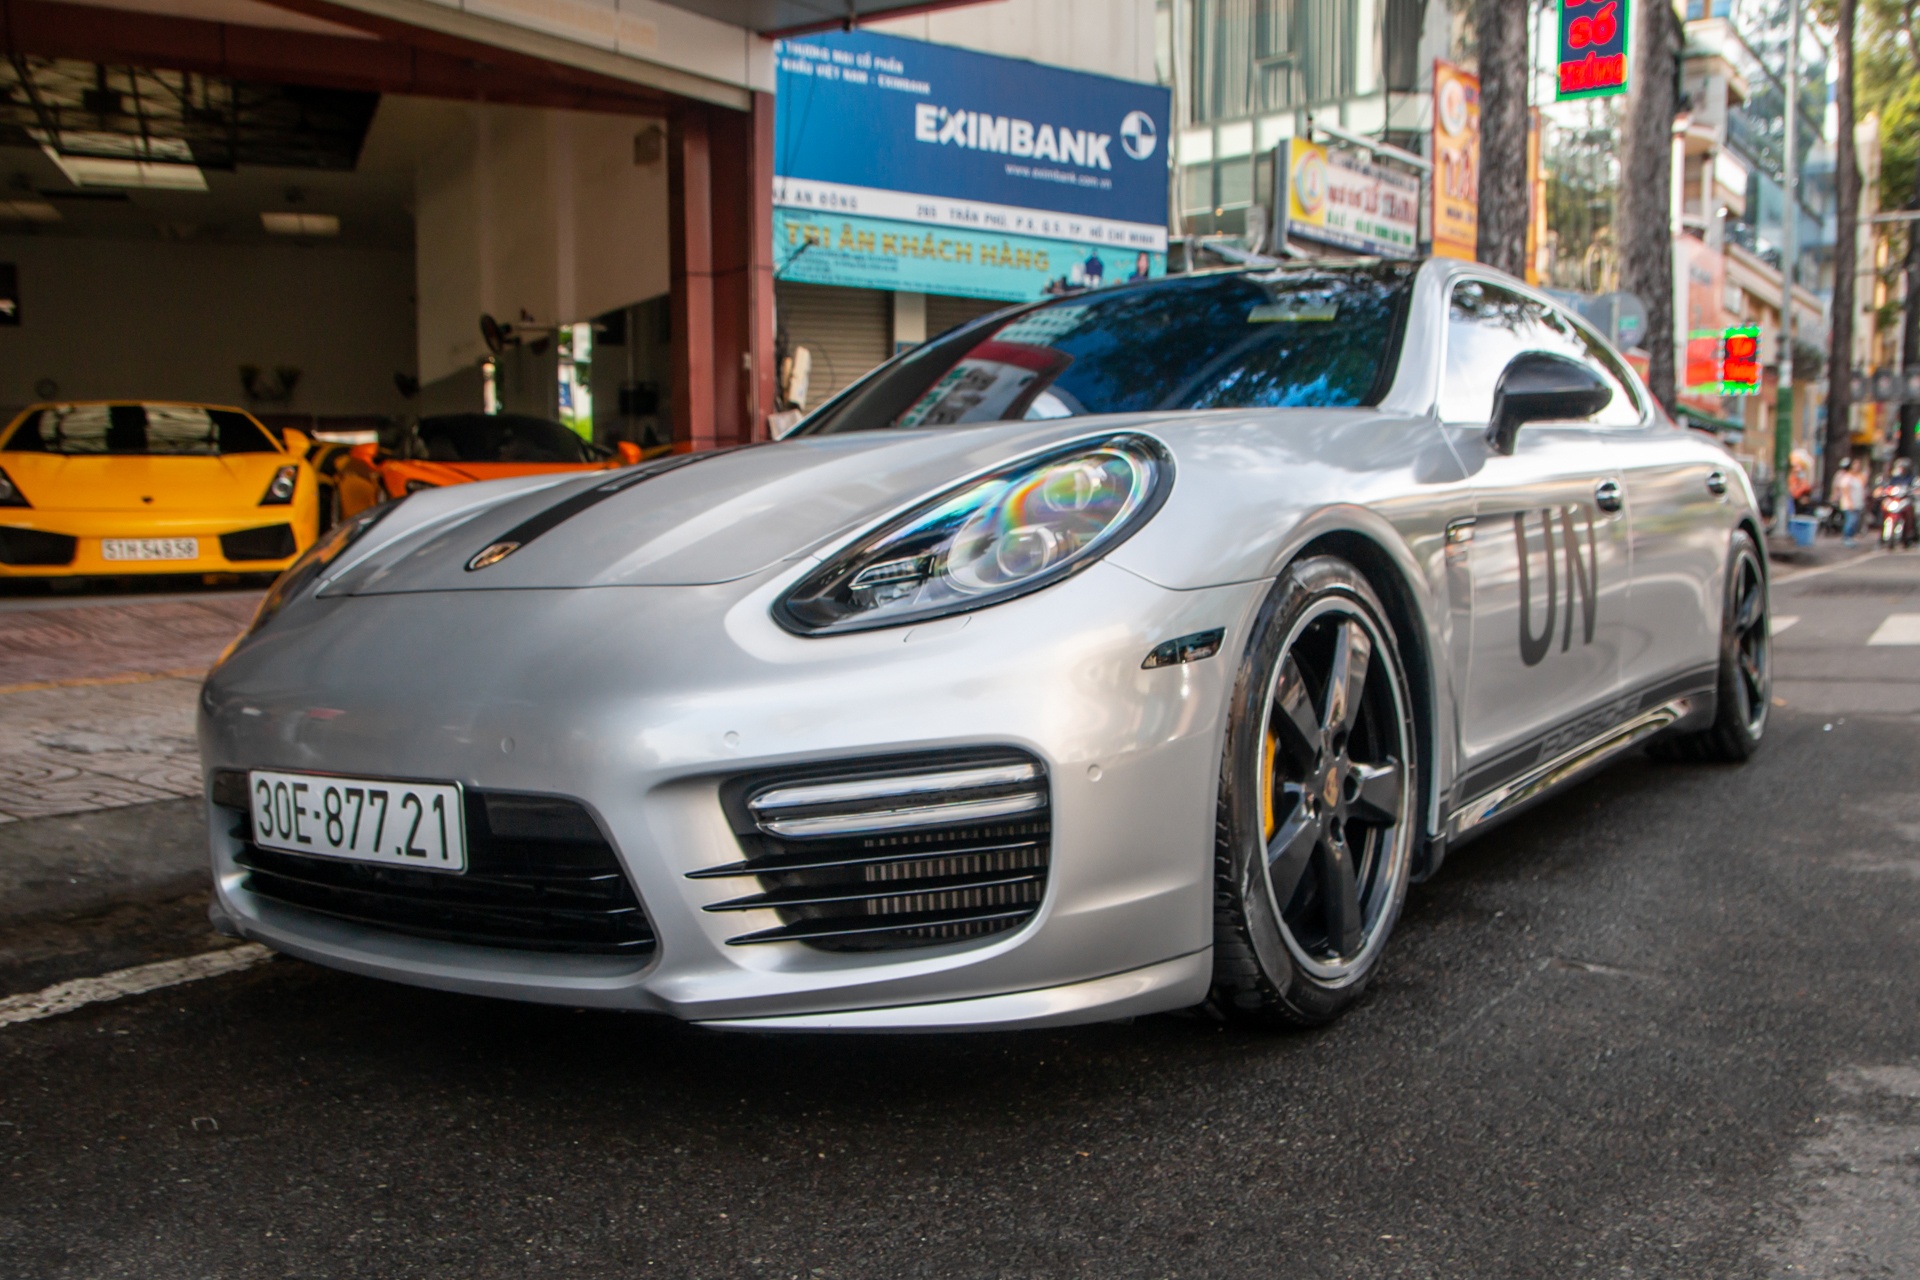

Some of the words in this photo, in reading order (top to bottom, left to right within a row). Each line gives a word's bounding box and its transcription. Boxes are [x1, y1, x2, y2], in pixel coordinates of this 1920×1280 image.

[843, 69, 868, 85] NAM
[878, 73, 931, 95] EXIMBANK
[915, 102, 1112, 170] EXIMBANK
[795, 191, 813, 204] AN
[784, 221, 830, 249] TRI
[838, 222, 876, 253] ÂN
[882, 231, 973, 264] KHÁCH
[980, 238, 1050, 272] HÀNG
[1089, 224, 1104, 239] HỒ
[1129, 231, 1156, 245] MINH
[1514, 505, 1597, 667] UN
